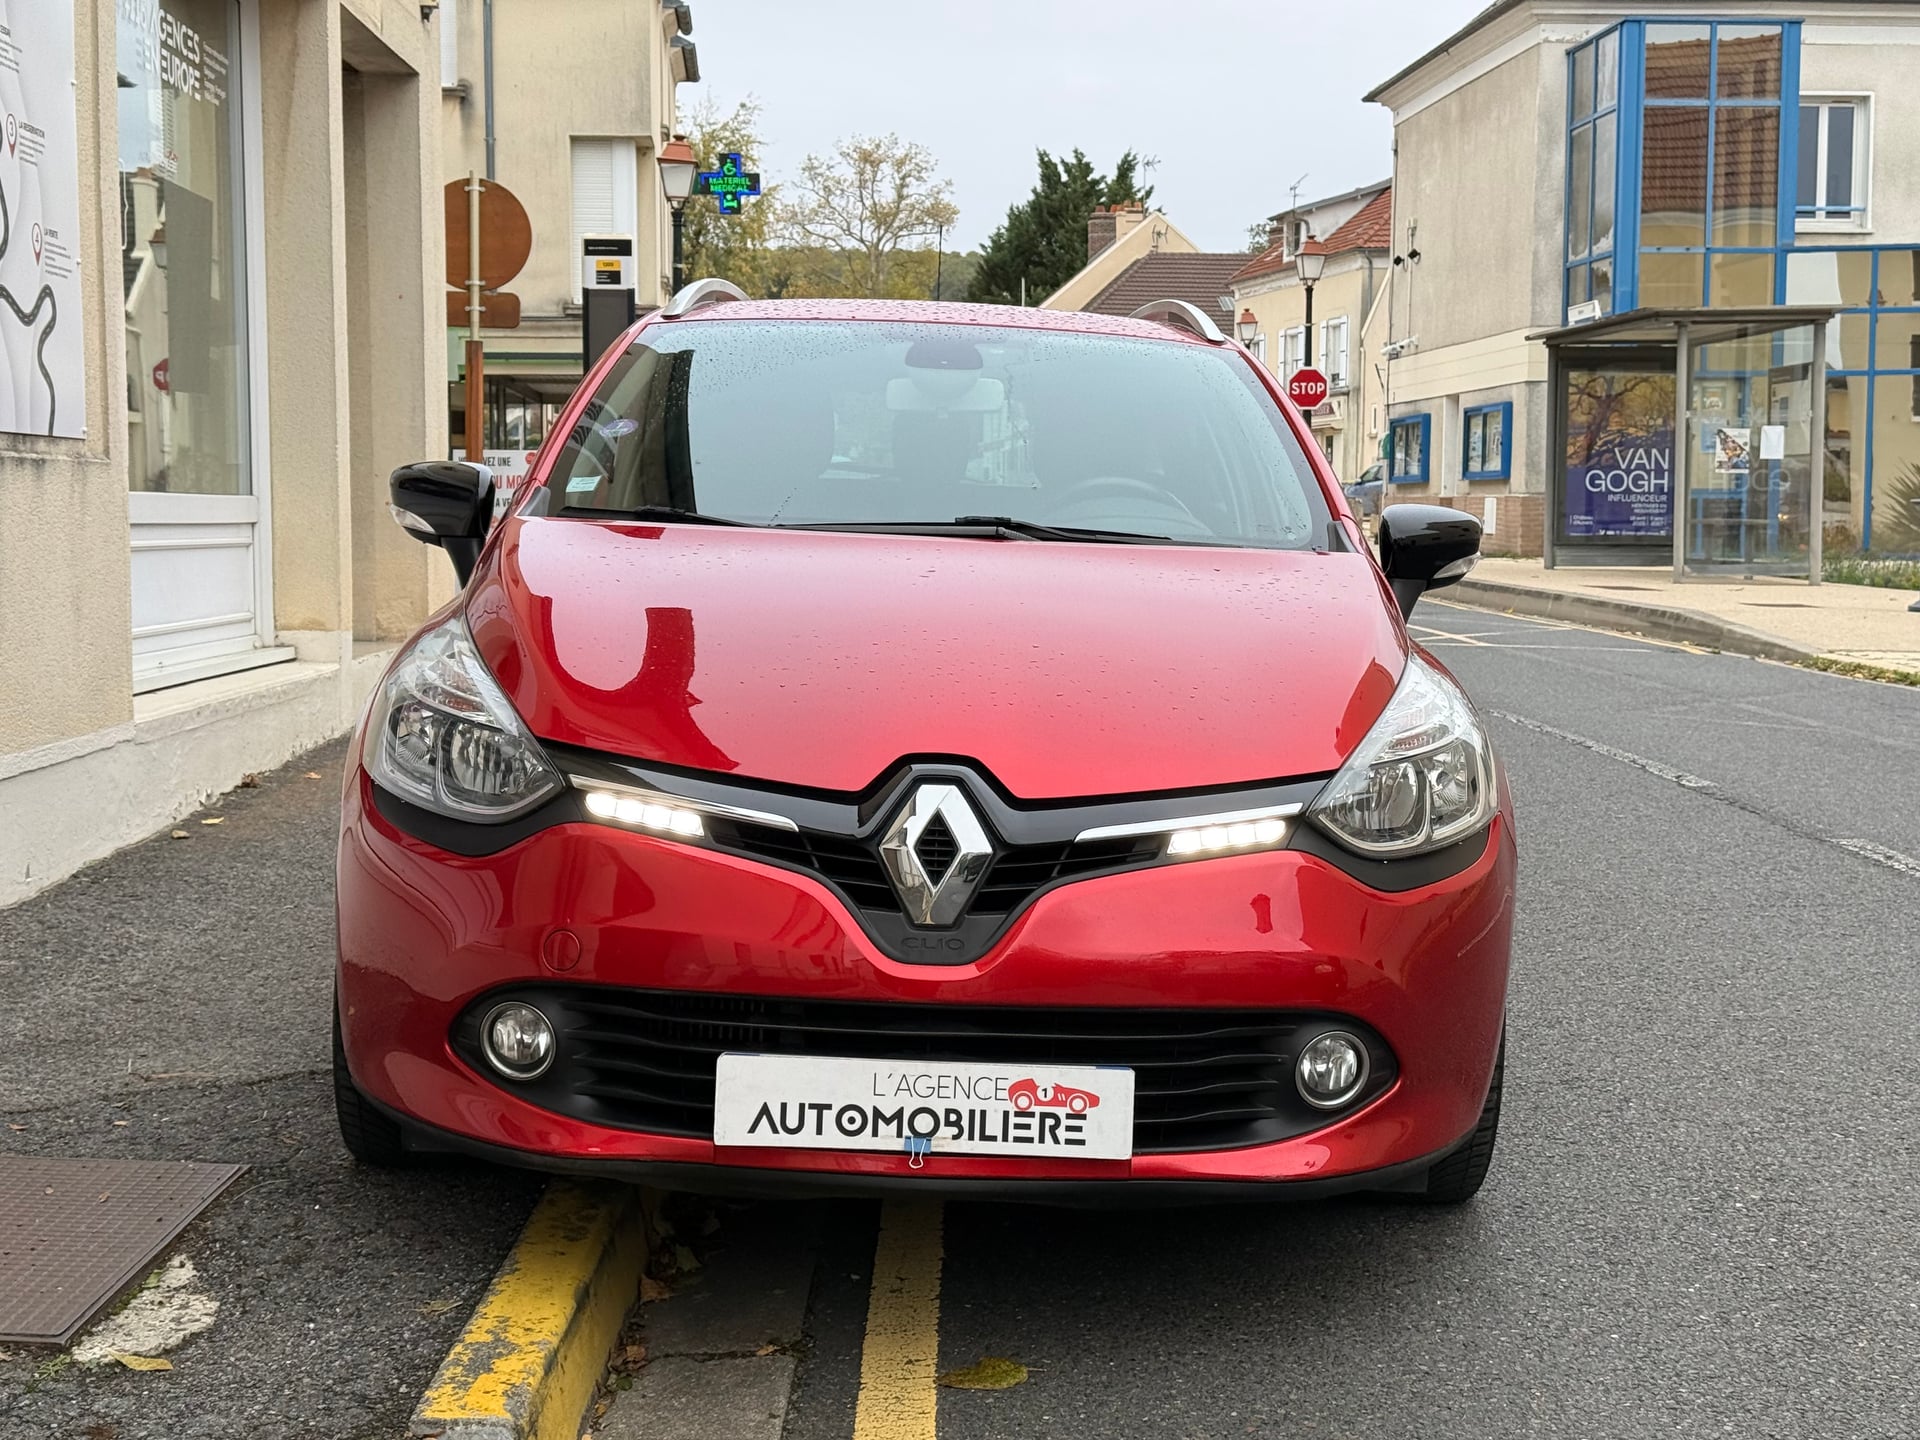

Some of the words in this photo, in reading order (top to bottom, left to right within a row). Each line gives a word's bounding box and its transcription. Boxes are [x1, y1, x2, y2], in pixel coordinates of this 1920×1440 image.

[147, 3, 200, 64] AGENCES
[161, 47, 200, 101] EUROPE
[1291, 382, 1325, 395] STOP
[482, 456, 496, 466] VEZ
[498, 456, 511, 466] UNE
[1614, 448, 1669, 470] VAN
[506, 475, 522, 489] MO
[1585, 469, 1668, 493] GOGH
[1607, 494, 1667, 502] INFLUENCEUR
[900, 936, 966, 952] CLIO
[873, 1072, 1009, 1101] L'AGENCE
[1041, 1087, 1048, 1099] 1
[747, 1101, 1088, 1147] AUTOMOBILIERE
